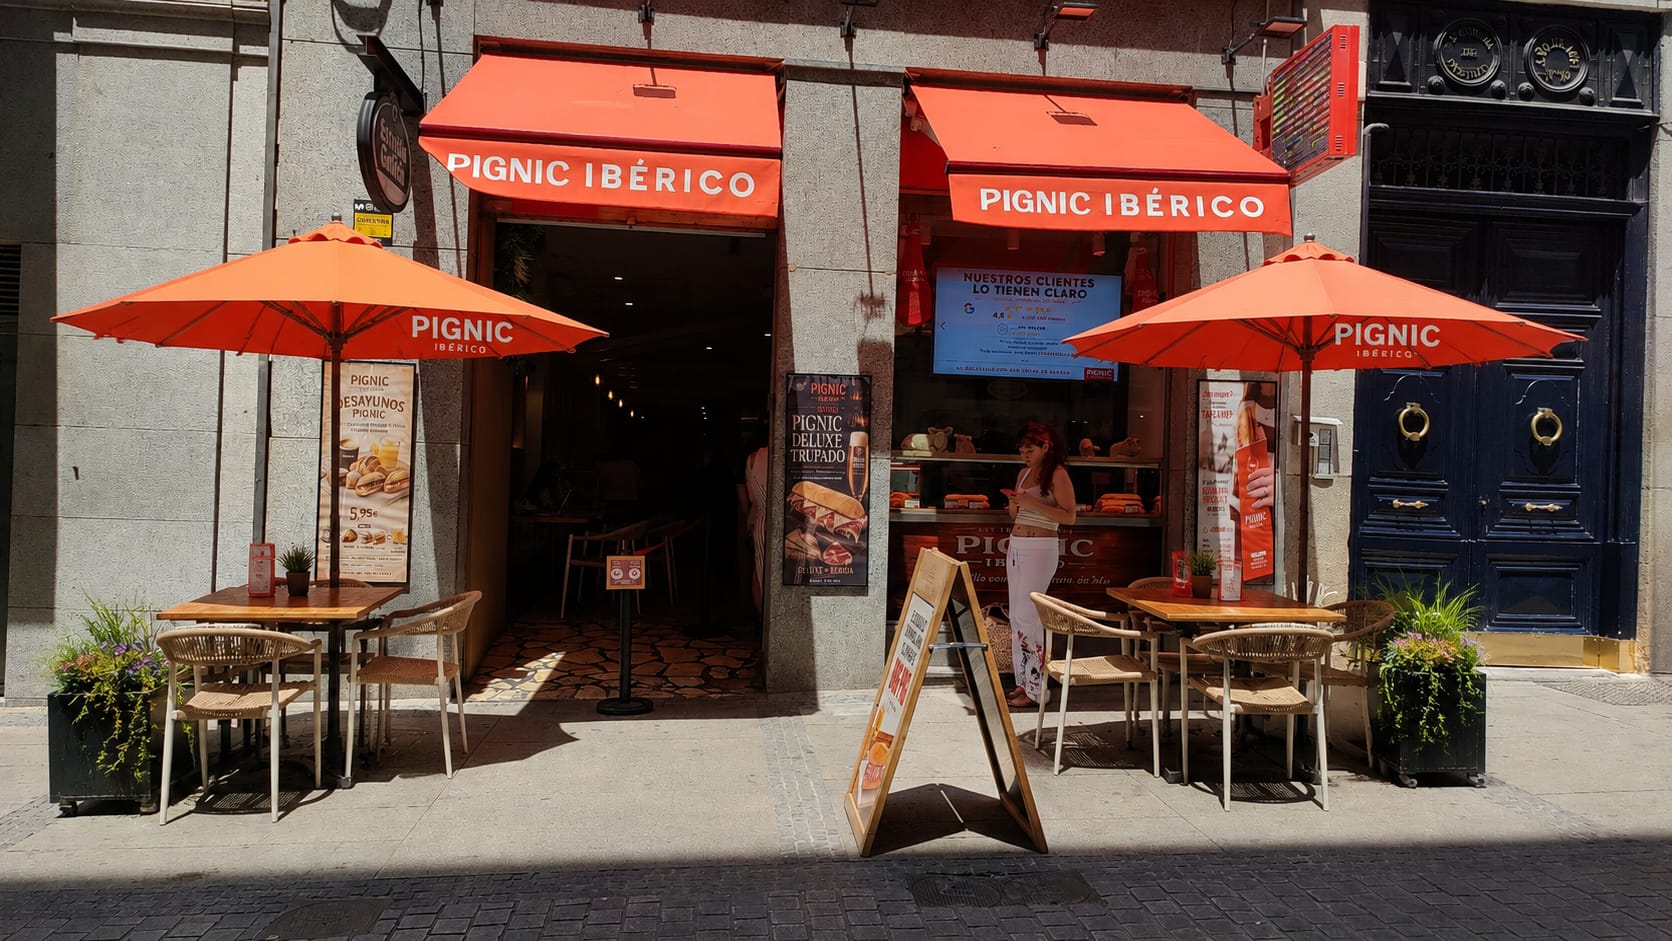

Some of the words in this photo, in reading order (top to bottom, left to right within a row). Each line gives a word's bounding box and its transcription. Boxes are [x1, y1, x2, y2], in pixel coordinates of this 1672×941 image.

[447, 153, 570, 186] PIGNIC
[586, 159, 756, 198] IBÉRICO
[980, 187, 1091, 215] PIGNIC
[1105, 187, 1264, 218] IBÉRICO
[963, 272, 1032, 286] NUESTROS
[1036, 274, 1095, 288] CLIENTES
[973, 284, 988, 295] LO
[994, 285, 1041, 297] TIENEN
[1044, 287, 1088, 299] CLARO
[411, 315, 513, 343] PIGNIC
[1335, 322, 1441, 348] PIGNIC
[351, 374, 389, 387] PIGNIC
[811, 382, 846, 396] PIGNIC
[792, 415, 842, 432] PIGNIC
[792, 432, 843, 448] DELUXE
[790, 449, 846, 463] TRUPADO
[956, 535, 1094, 558] PIIC
